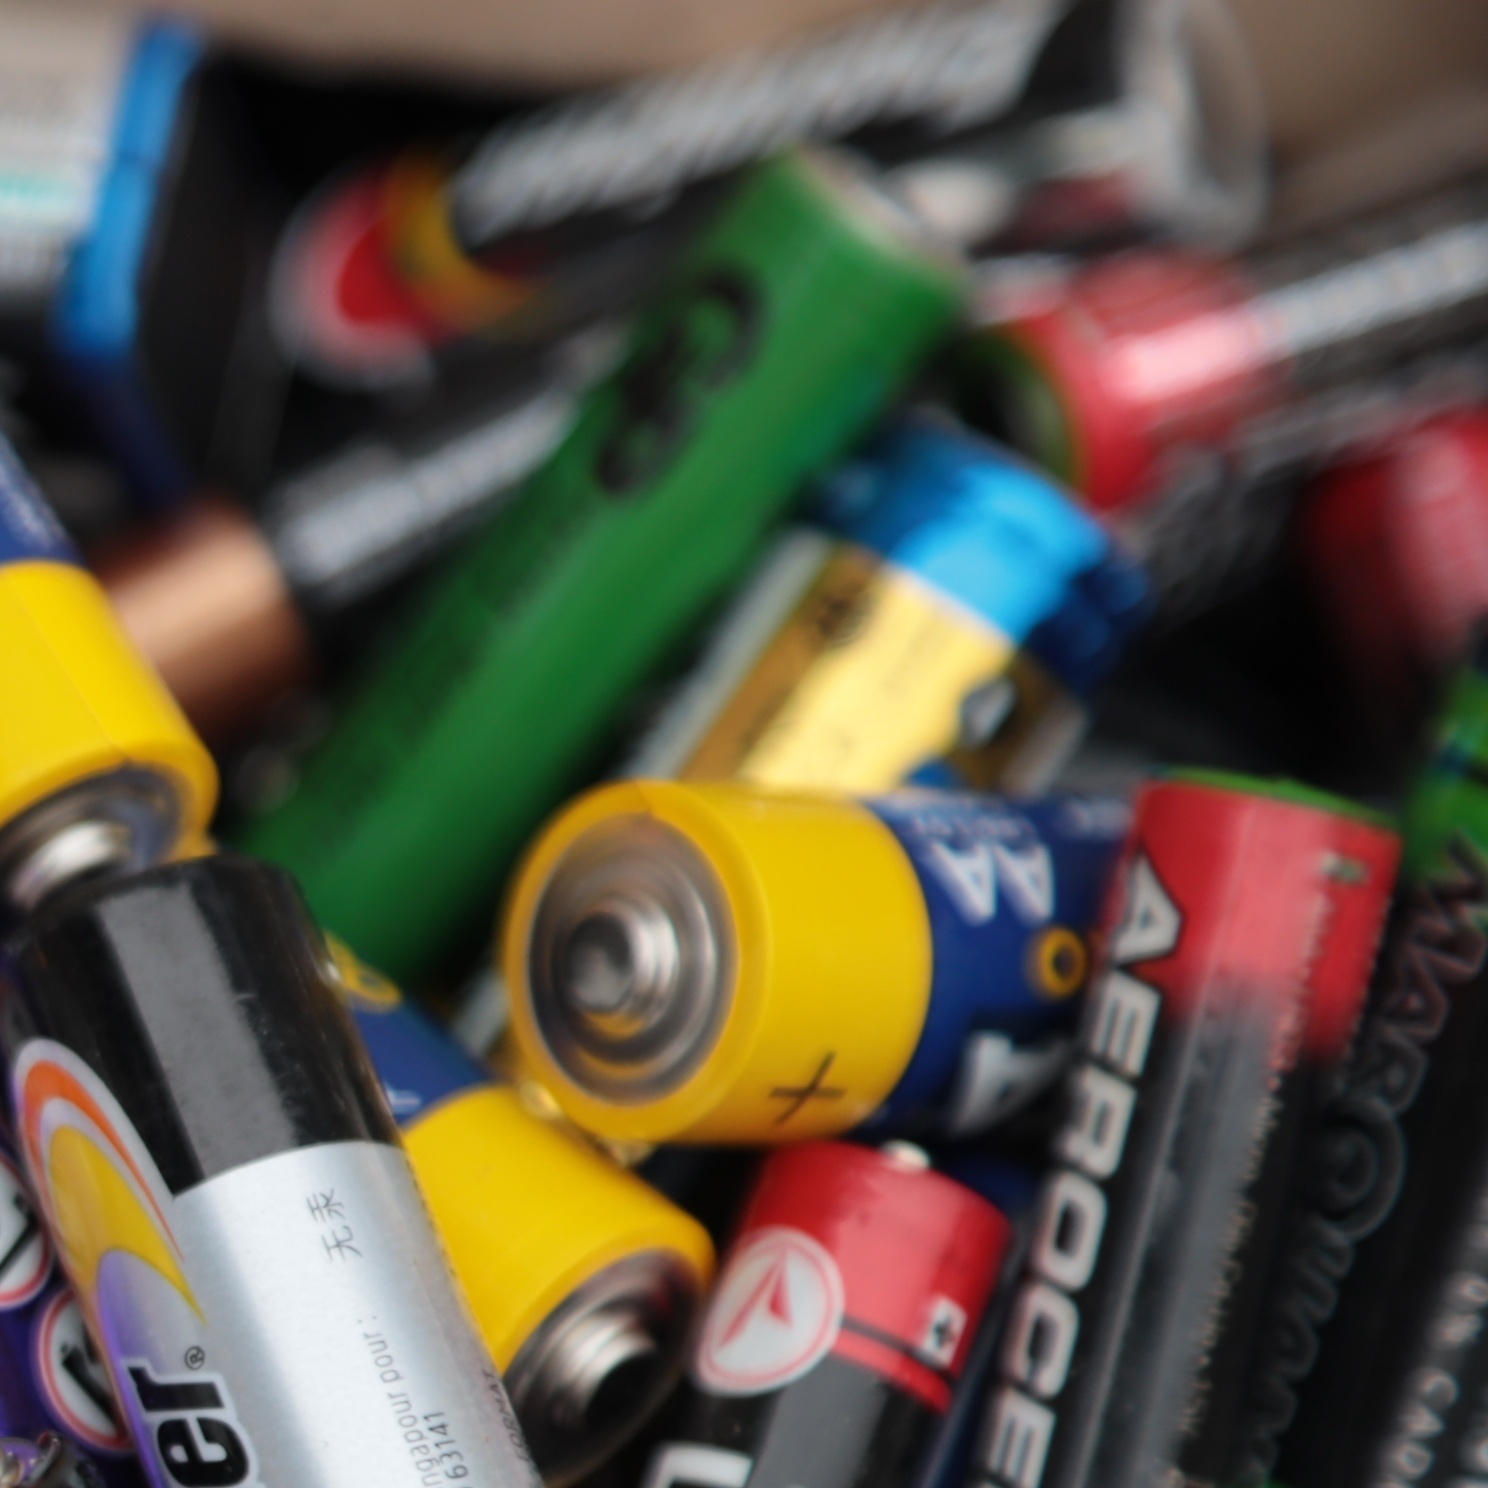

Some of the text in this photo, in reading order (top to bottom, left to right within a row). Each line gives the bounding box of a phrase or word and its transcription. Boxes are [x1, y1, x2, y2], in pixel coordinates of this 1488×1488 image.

[927, 840, 1056, 926] AA
[303, 1182, 365, 1268] 无汞
[358, 1321, 405, 1386] pour
[421, 1405, 470, 1482] 63141
